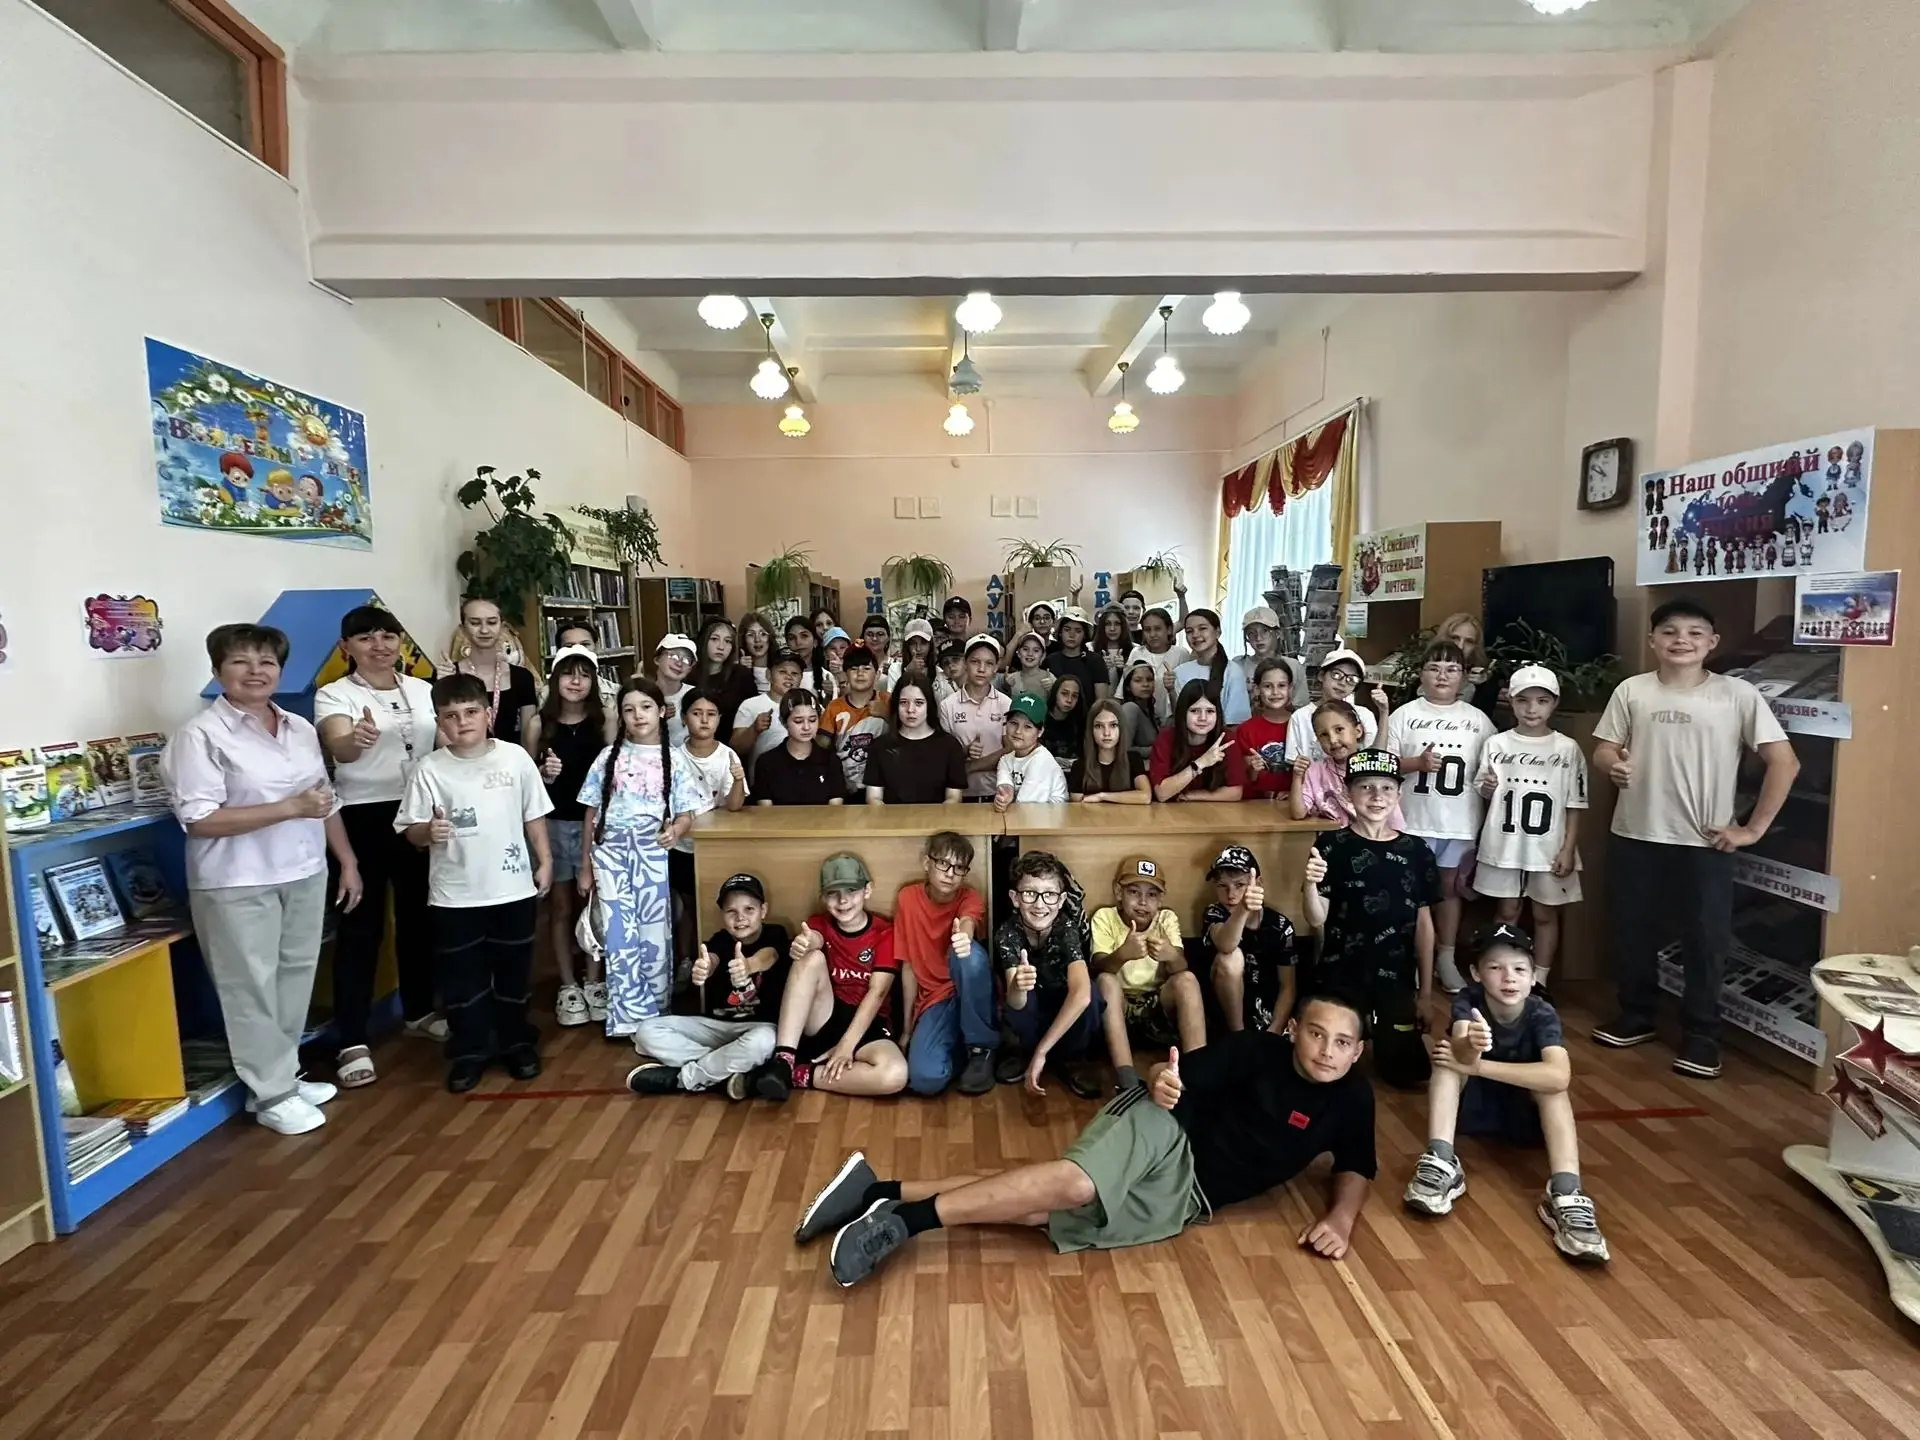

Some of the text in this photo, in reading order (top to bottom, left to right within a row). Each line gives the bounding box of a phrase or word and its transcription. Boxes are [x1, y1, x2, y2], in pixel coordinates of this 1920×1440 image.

[1669, 473, 1716, 497] Наш
[1414, 755, 1466, 797] 10
[1502, 789, 1553, 836] 10
